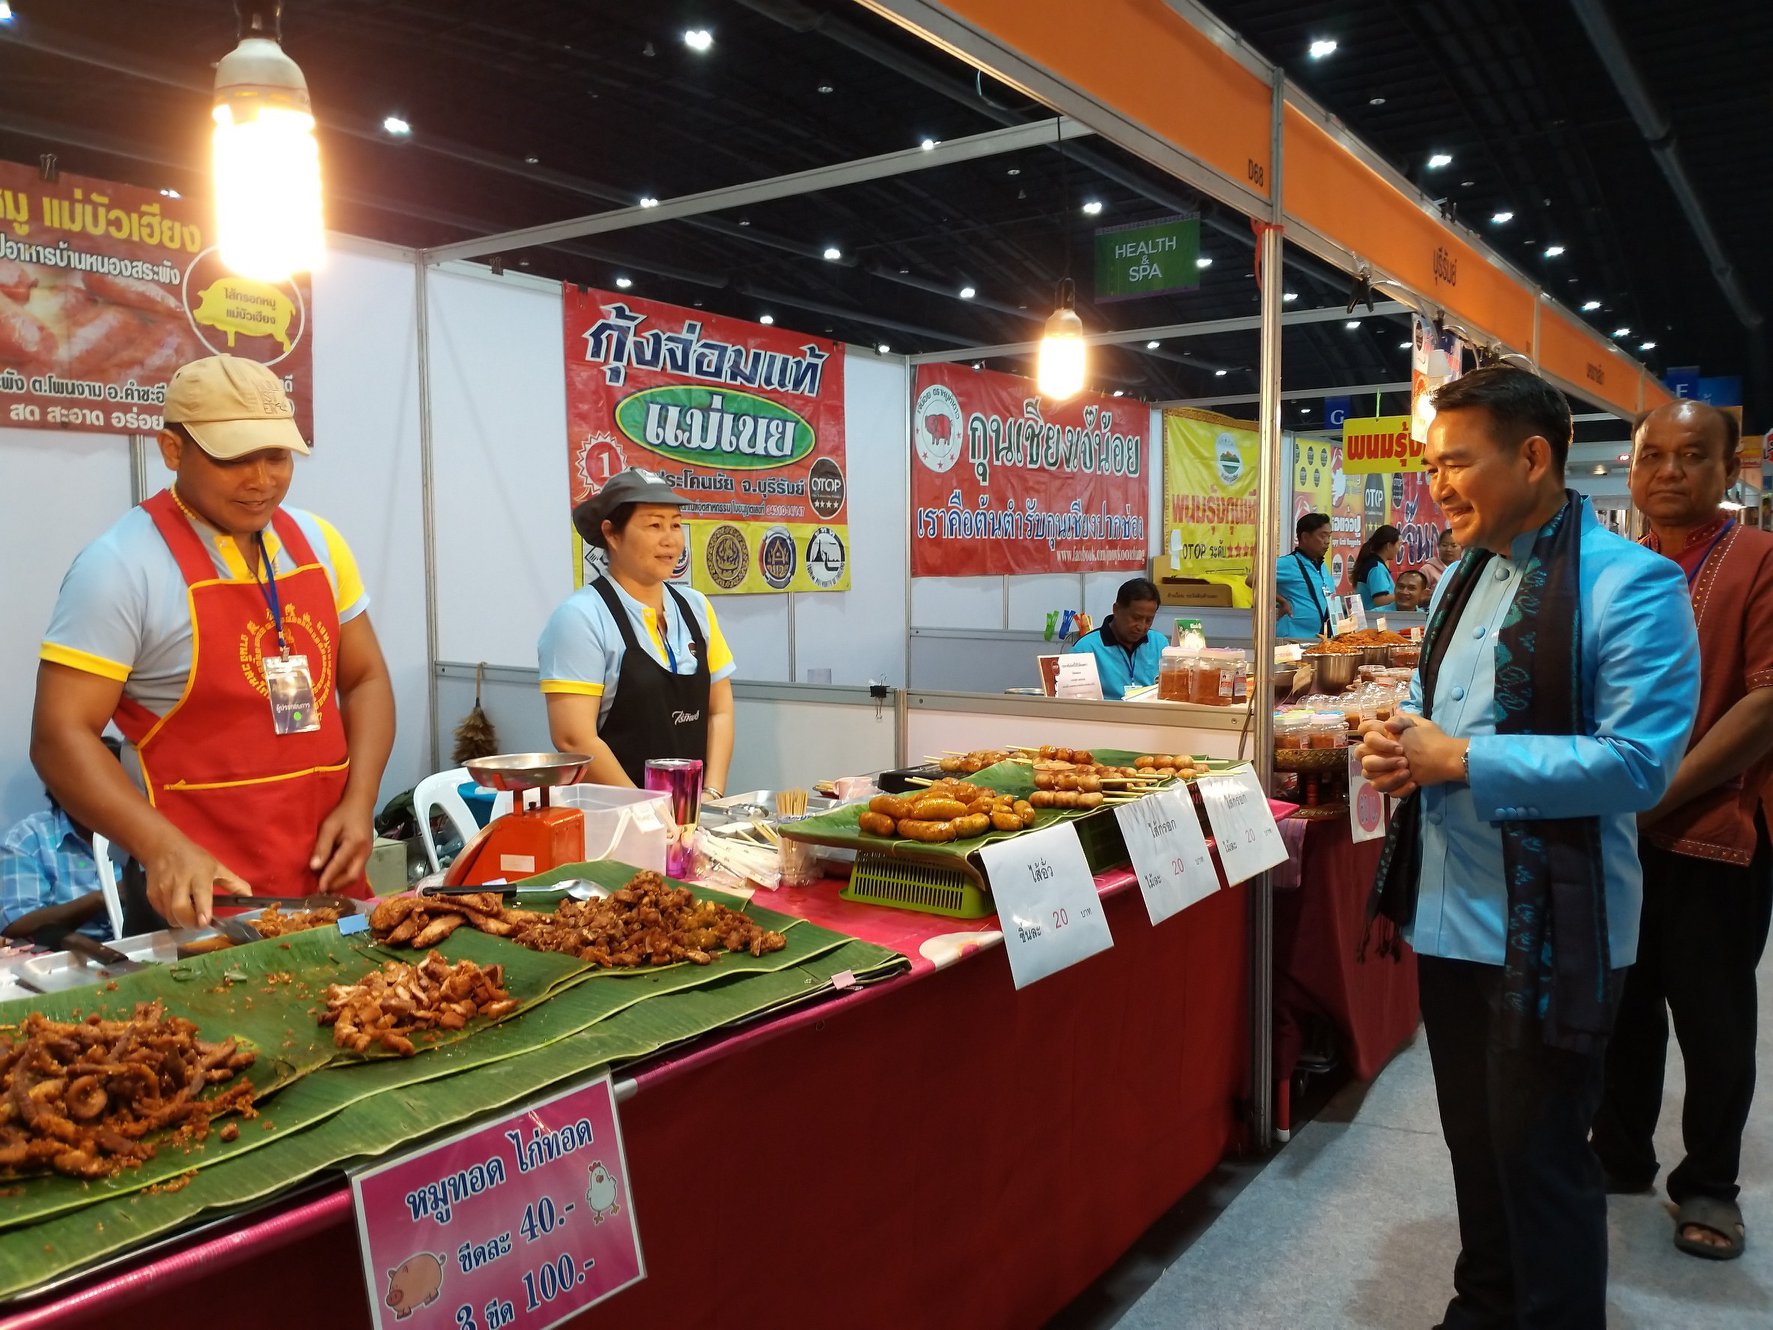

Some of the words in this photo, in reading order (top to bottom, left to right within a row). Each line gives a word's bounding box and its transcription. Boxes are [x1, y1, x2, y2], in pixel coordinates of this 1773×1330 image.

[1248, 159, 1264, 188] D68
[0, 188, 29, 236] มู
[42, 188, 201, 253] แม่บัวเฮียง
[1115, 236, 1176, 258] HEALTH
[1142, 255, 1149, 264] &
[1129, 263, 1162, 281] SPA
[582, 302, 832, 397] กุ้งจ่อมแท้
[31, 374, 103, 398] ต.โพนงาม
[10, 403, 41, 422] สด
[47, 406, 105, 427] สะอาด
[111, 407, 165, 431] อร่อย
[1330, 410, 1345, 425] G
[598, 452, 610, 478] 1
[659, 469, 735, 492] ระโคนชัย
[811, 477, 842, 492] OTOP
[1365, 488, 1384, 507] OTOP
[1183, 543, 1206, 560] OTOP
[1148, 820, 1177, 839] ไส้กรอก
[1245, 828, 1256, 843] 20
[1028, 857, 1054, 883] ไส้อั่ว
[1171, 858, 1185, 875] 20
[1052, 908, 1069, 929] 20
[1081, 907, 1092, 918] บาท
[405, 1157, 506, 1226] หมูทอด
[505, 1118, 594, 1174] ไก่ทอด
[458, 1232, 512, 1274] ขีดละ
[520, 1197, 575, 1243] 40.-
[485, 1300, 514, 1330] ขีด
[522, 1254, 596, 1312] 100.-
